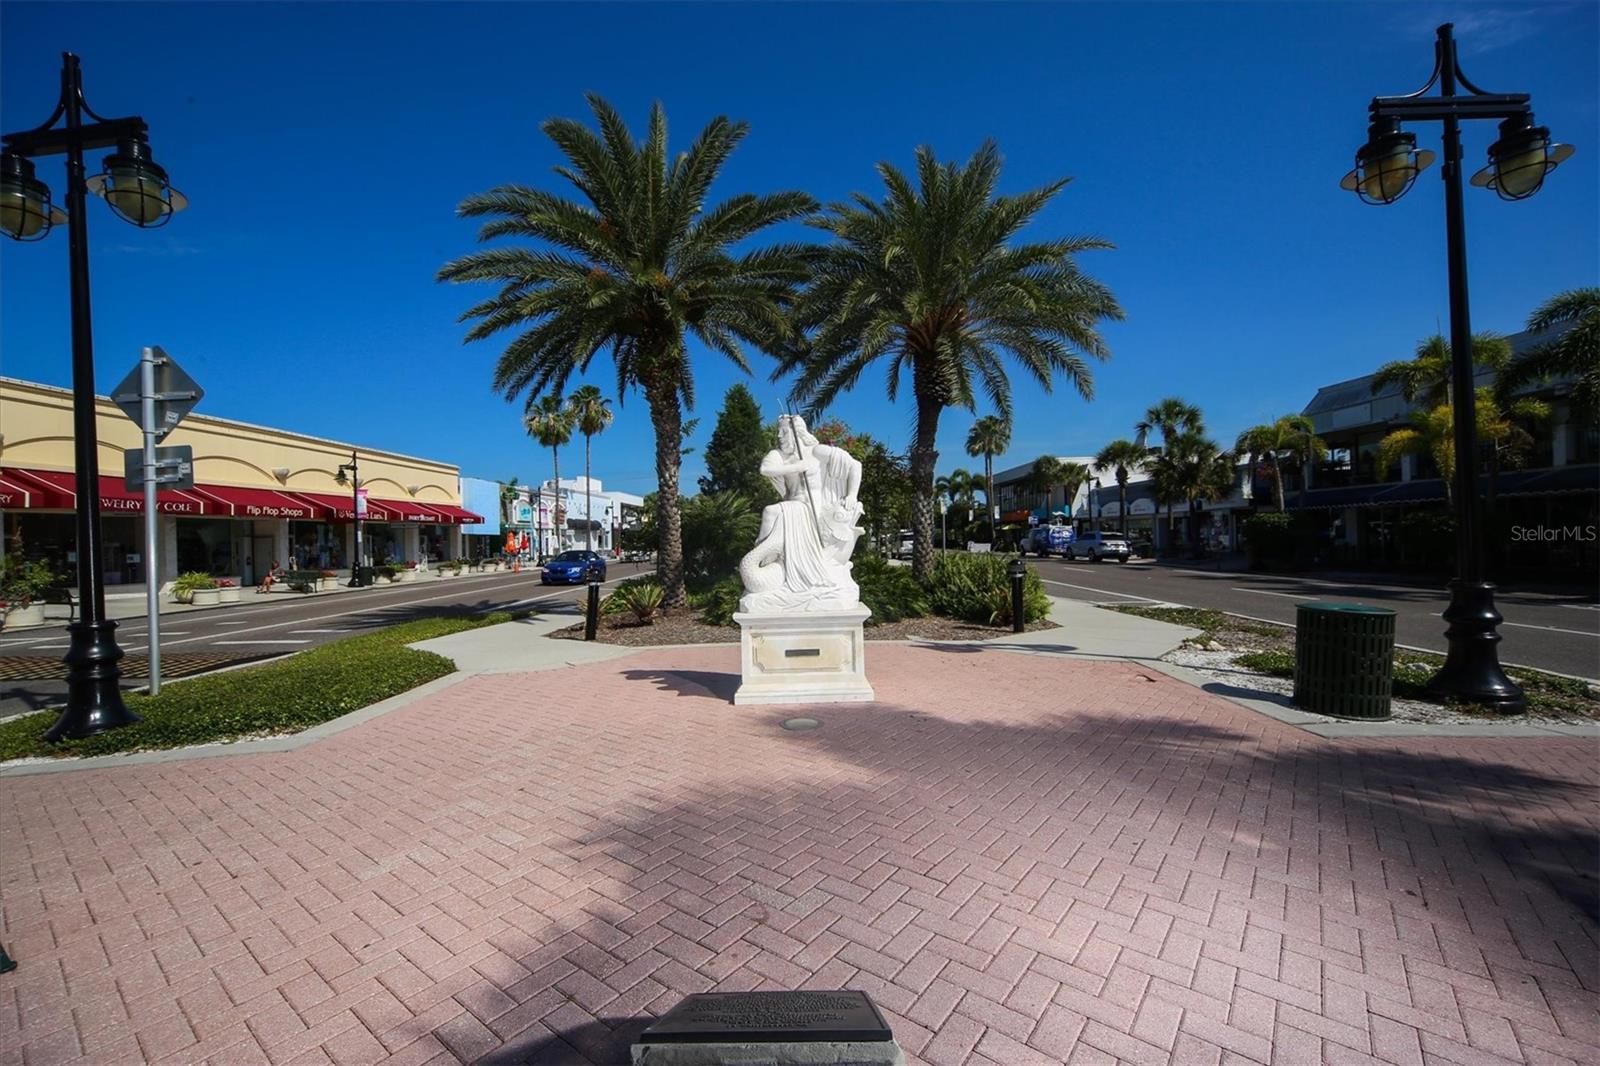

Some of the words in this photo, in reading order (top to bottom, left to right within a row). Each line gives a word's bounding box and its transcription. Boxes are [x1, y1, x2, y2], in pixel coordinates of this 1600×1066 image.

[101, 498, 142, 509] WELRY
[164, 502, 192, 512] COLE
[247, 505, 261, 516] Flip
[262, 506, 279, 517] Flop
[280, 507, 303, 518] Shops
